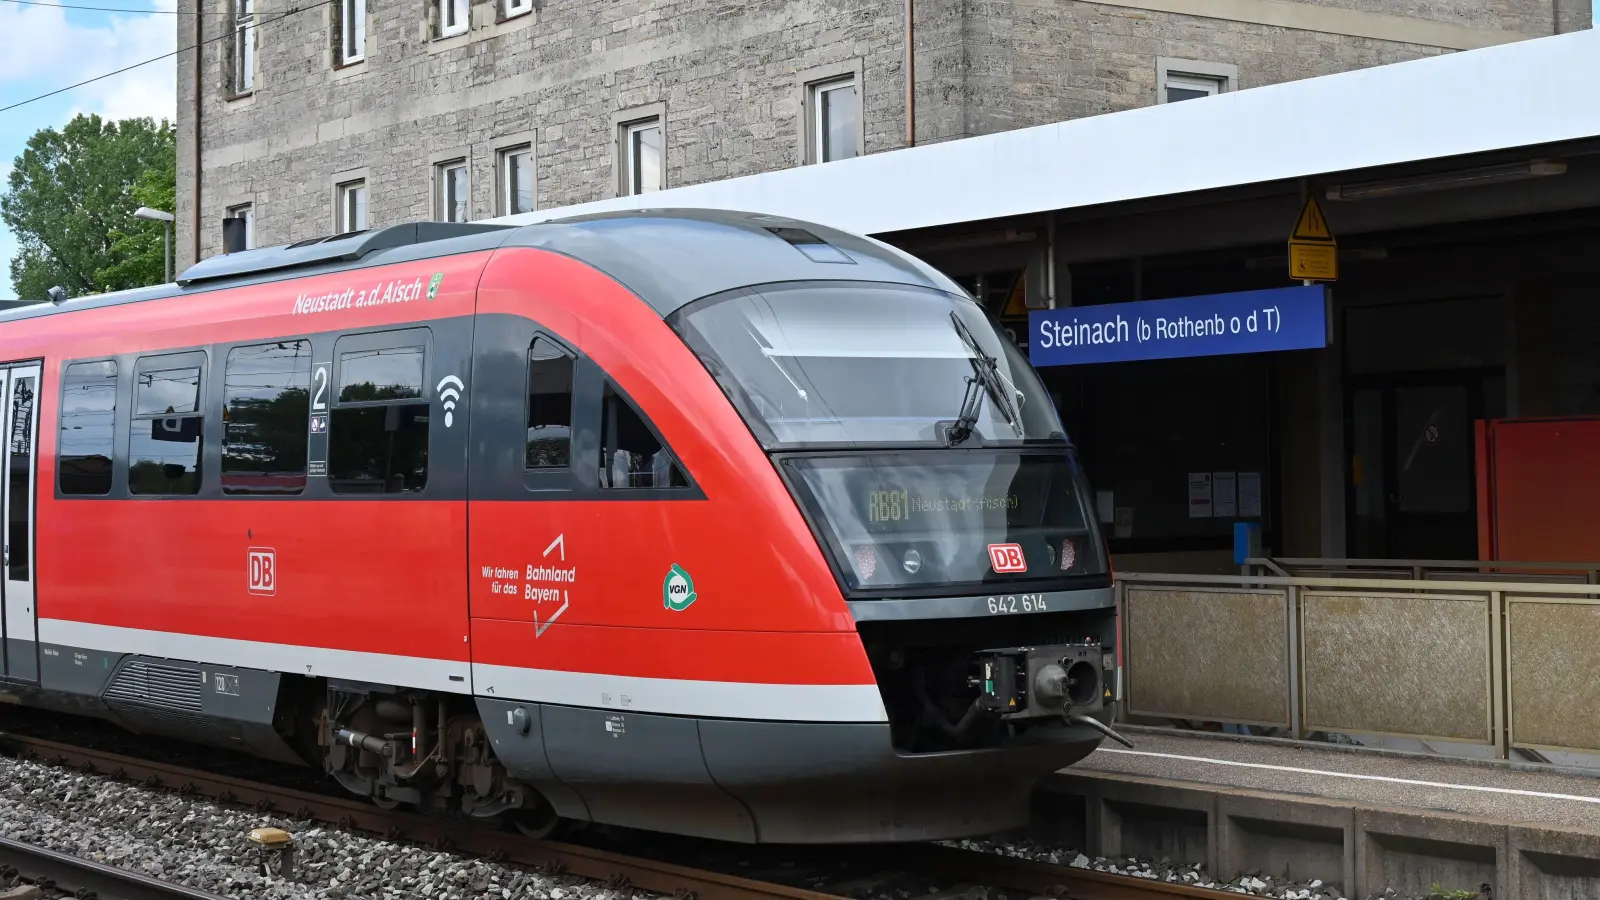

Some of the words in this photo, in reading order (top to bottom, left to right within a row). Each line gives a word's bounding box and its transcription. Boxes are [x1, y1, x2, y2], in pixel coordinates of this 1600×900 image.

[292, 286, 355, 316] Neustadt
[1040, 314, 1129, 349] Steinach
[1136, 316, 1151, 344] (b
[1156, 313, 1225, 340] Rothenb
[1230, 316, 1241, 334] o
[1246, 310, 1258, 333] d
[1263, 305, 1281, 334] T)
[312, 366, 327, 410] 2
[869, 489, 909, 522] RB81
[992, 548, 1022, 568] DB
[251, 555, 273, 587] DB
[481, 566, 494, 579] Wir
[494, 566, 519, 580] fahren
[526, 564, 576, 583] Bahnland
[491, 582, 502, 594] für
[503, 583, 518, 595] das
[524, 584, 560, 604] Bayern
[669, 584, 687, 594] VGN
[987, 596, 1018, 614] 642
[1022, 594, 1047, 612] 614
